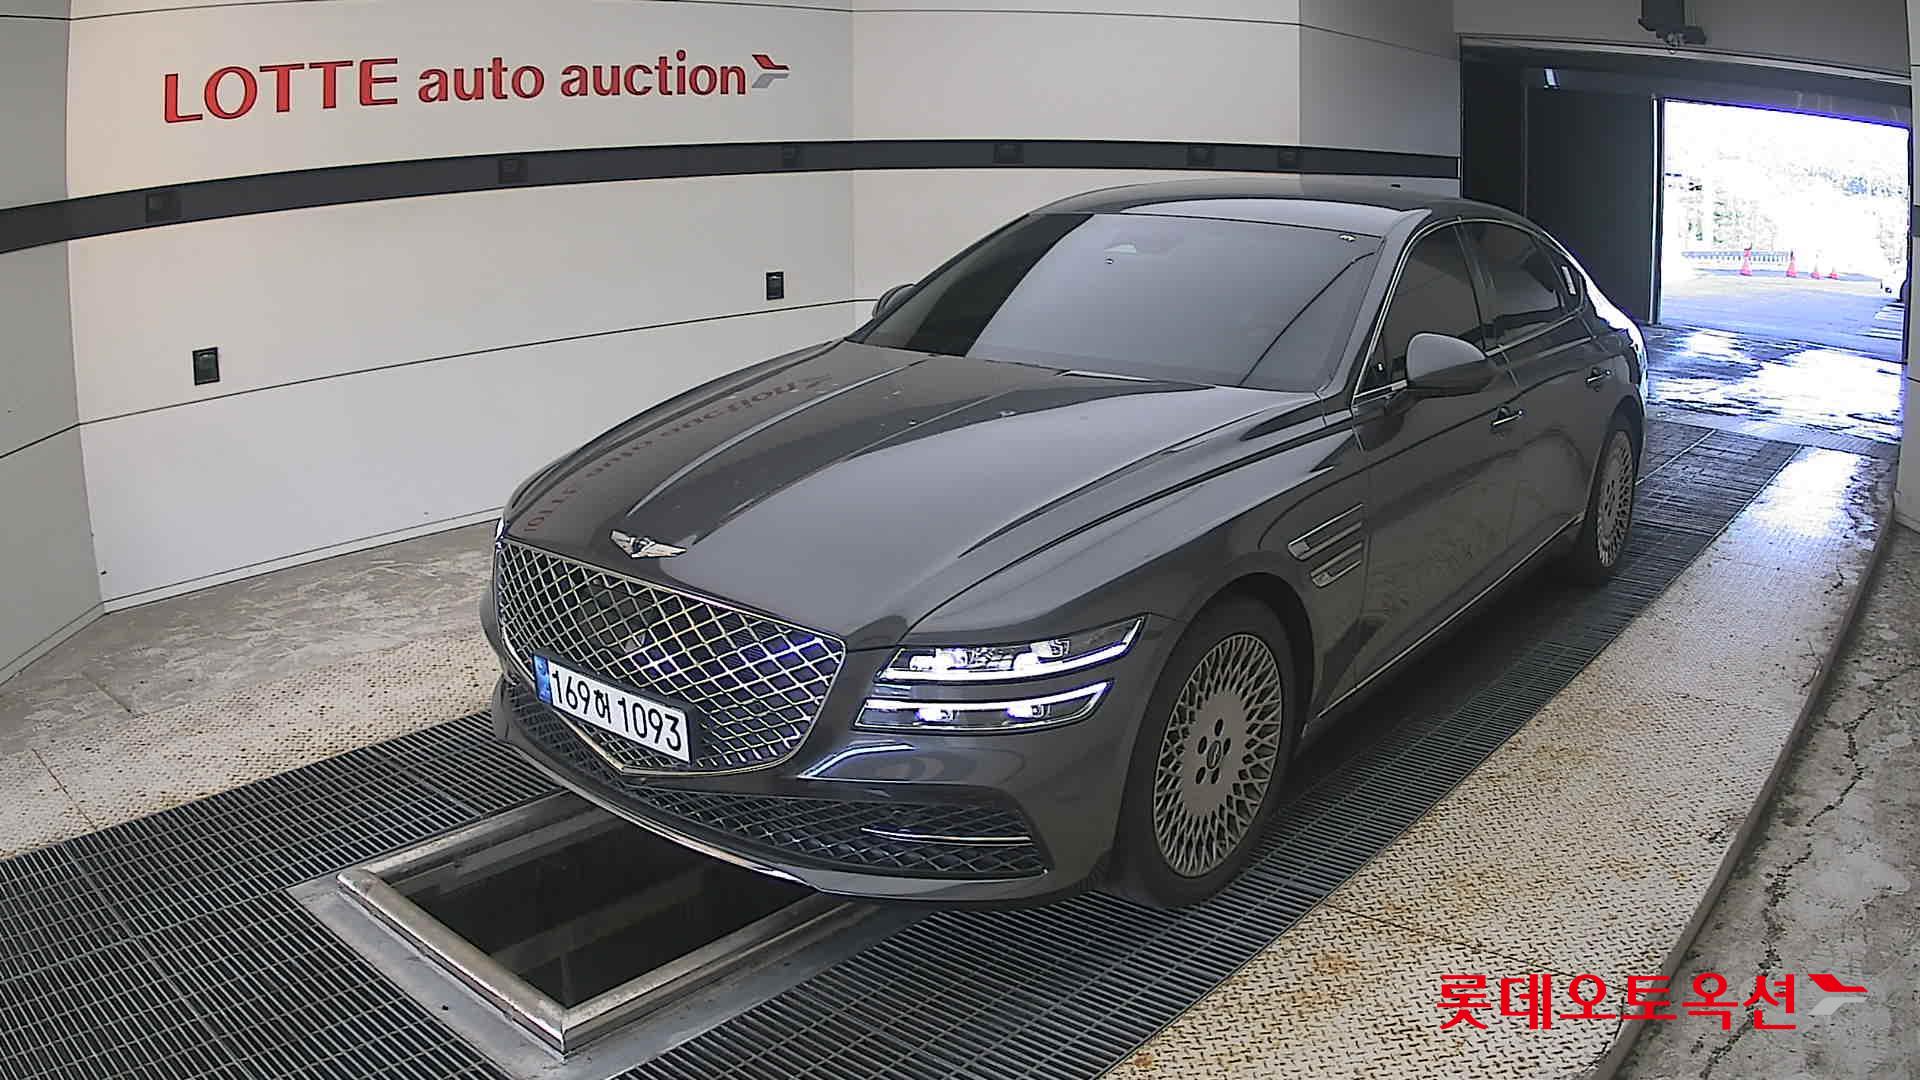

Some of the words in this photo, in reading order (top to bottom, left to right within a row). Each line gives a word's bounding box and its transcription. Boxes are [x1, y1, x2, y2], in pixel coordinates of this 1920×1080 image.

[164, 57, 399, 124] LOTTE
[417, 57, 545, 103] auto
[560, 49, 748, 97] auction
[618, 697, 682, 752] 1093
